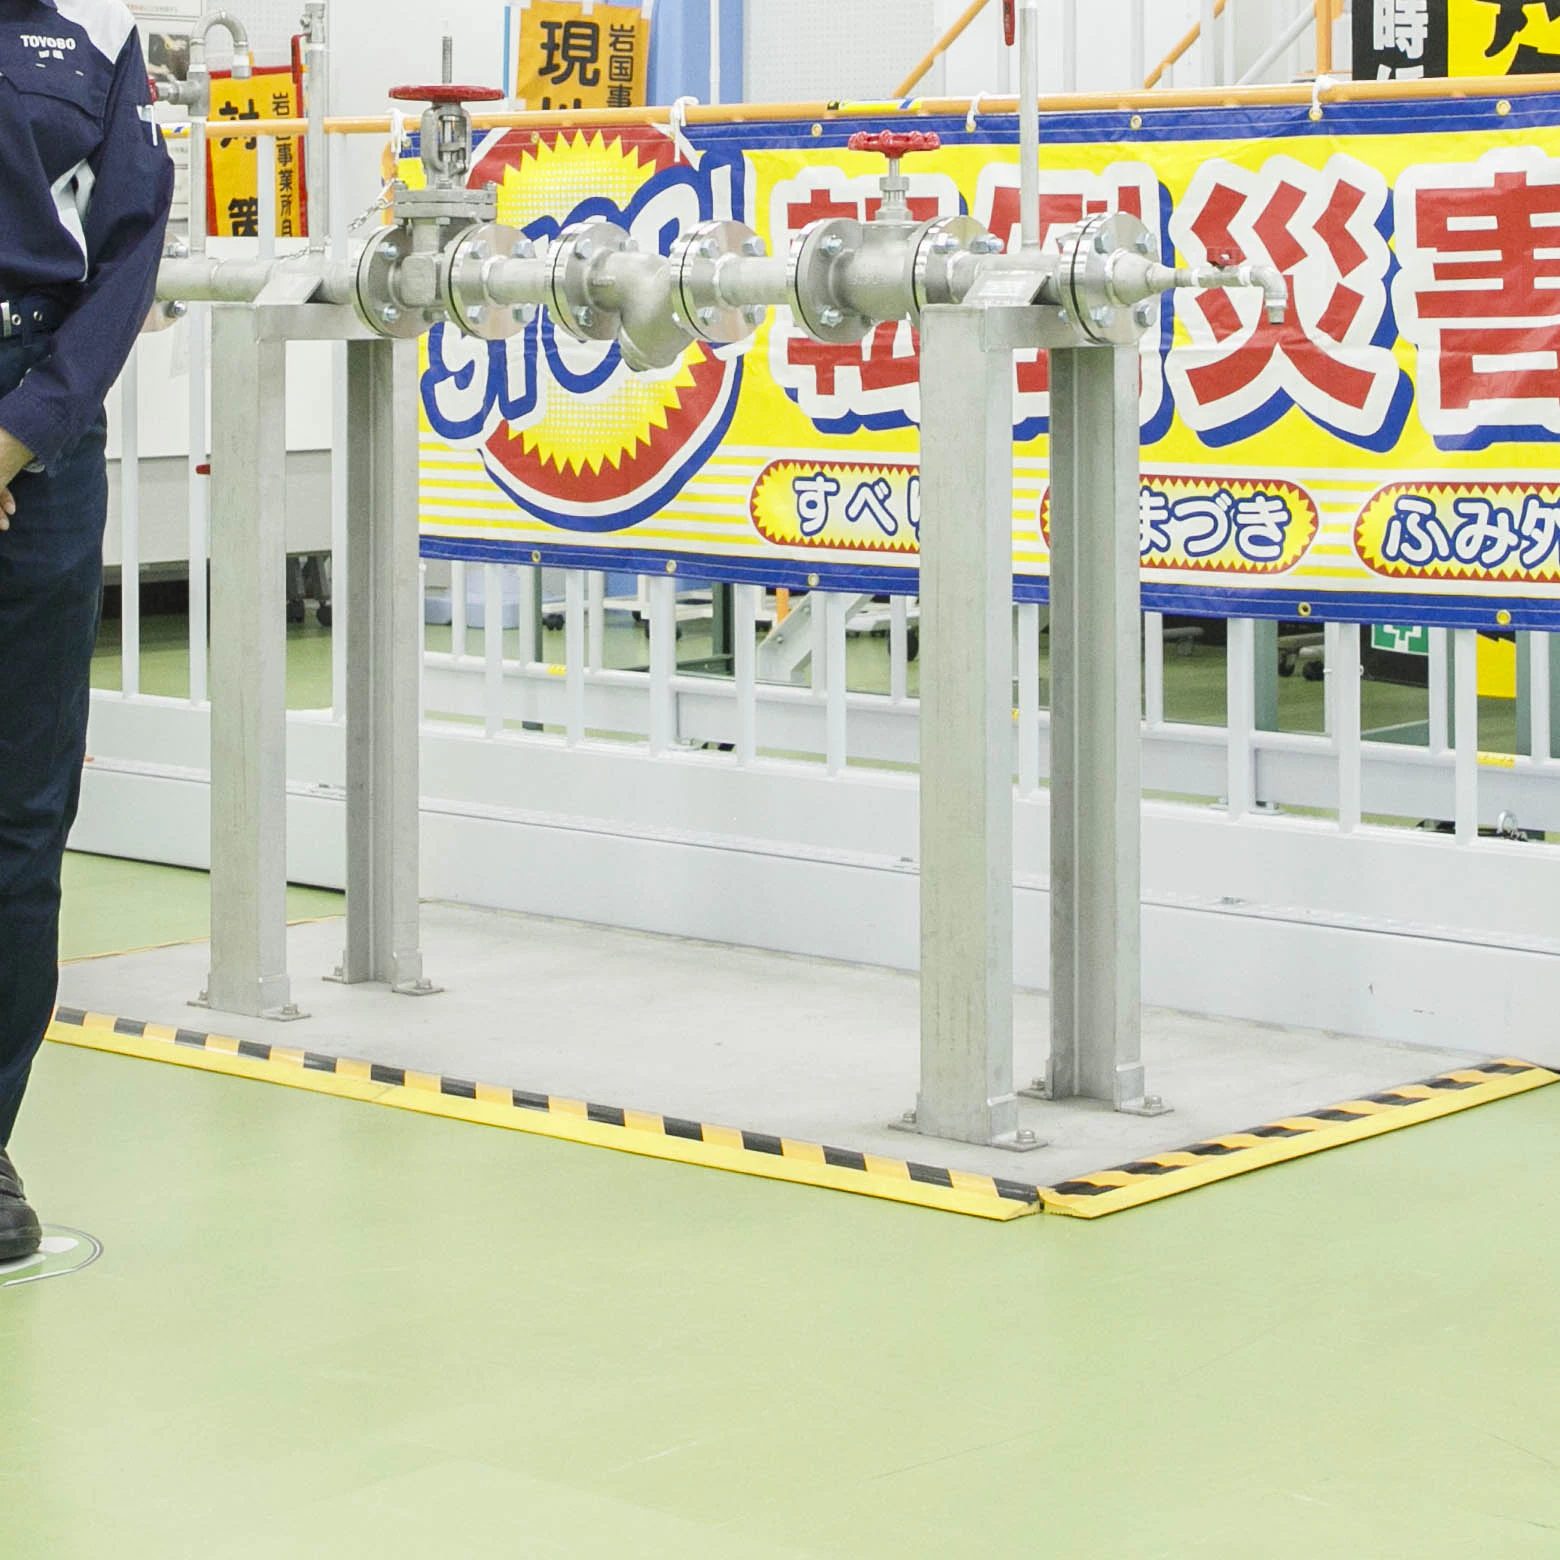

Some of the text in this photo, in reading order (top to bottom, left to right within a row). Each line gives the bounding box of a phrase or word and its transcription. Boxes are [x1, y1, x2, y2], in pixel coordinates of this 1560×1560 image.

[20, 34, 76, 51] TOYOBO
[1140, 488, 1290, 560] まづき
